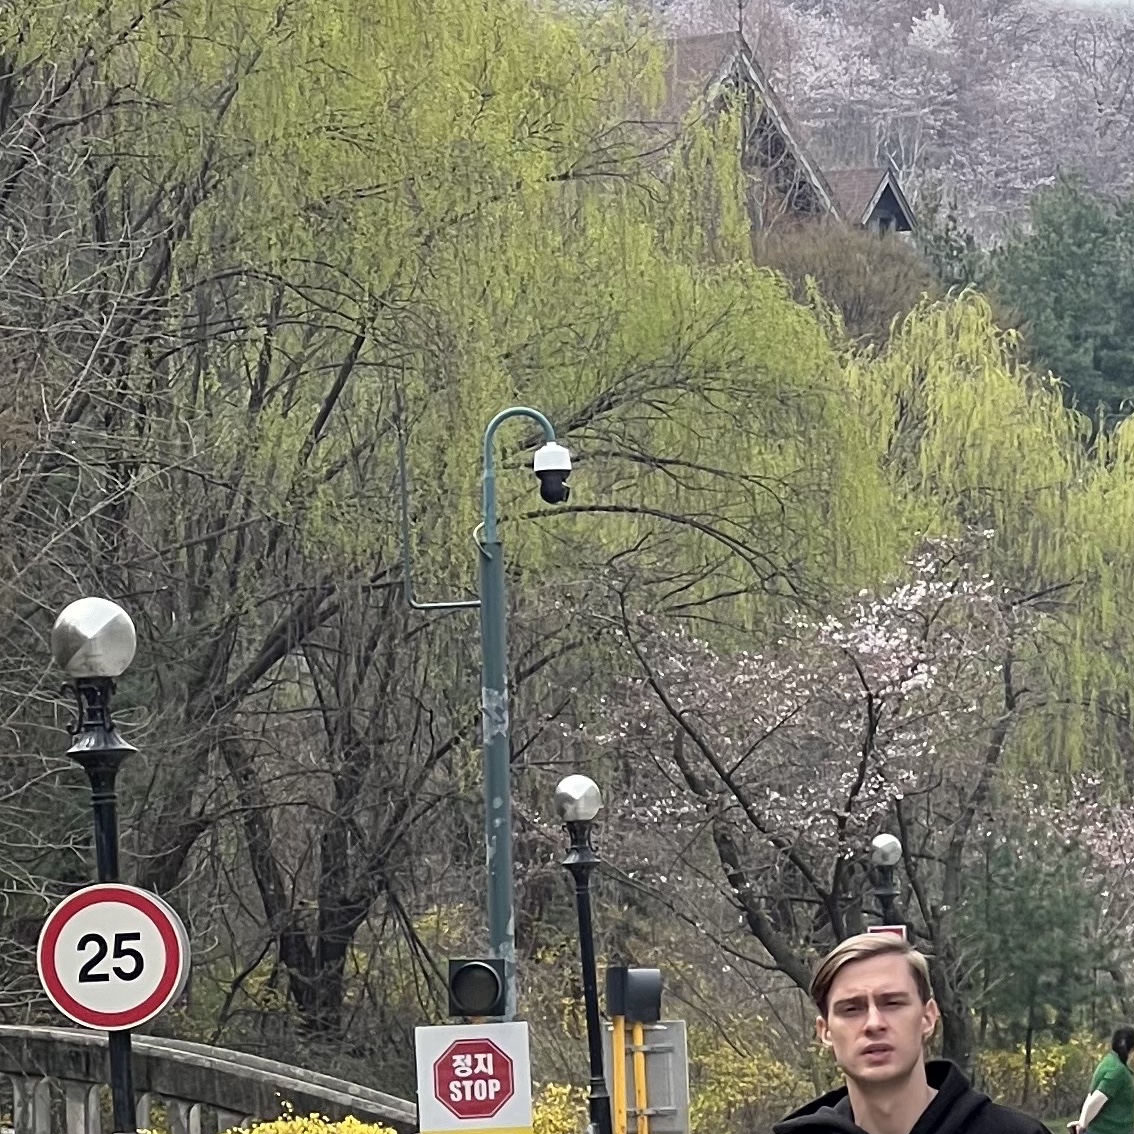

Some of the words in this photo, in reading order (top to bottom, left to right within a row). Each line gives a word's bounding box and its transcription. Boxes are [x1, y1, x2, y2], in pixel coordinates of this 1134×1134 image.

[77, 932, 145, 983] 25
[452, 1053, 494, 1078] 정지
[449, 1079, 501, 1102] STOP
